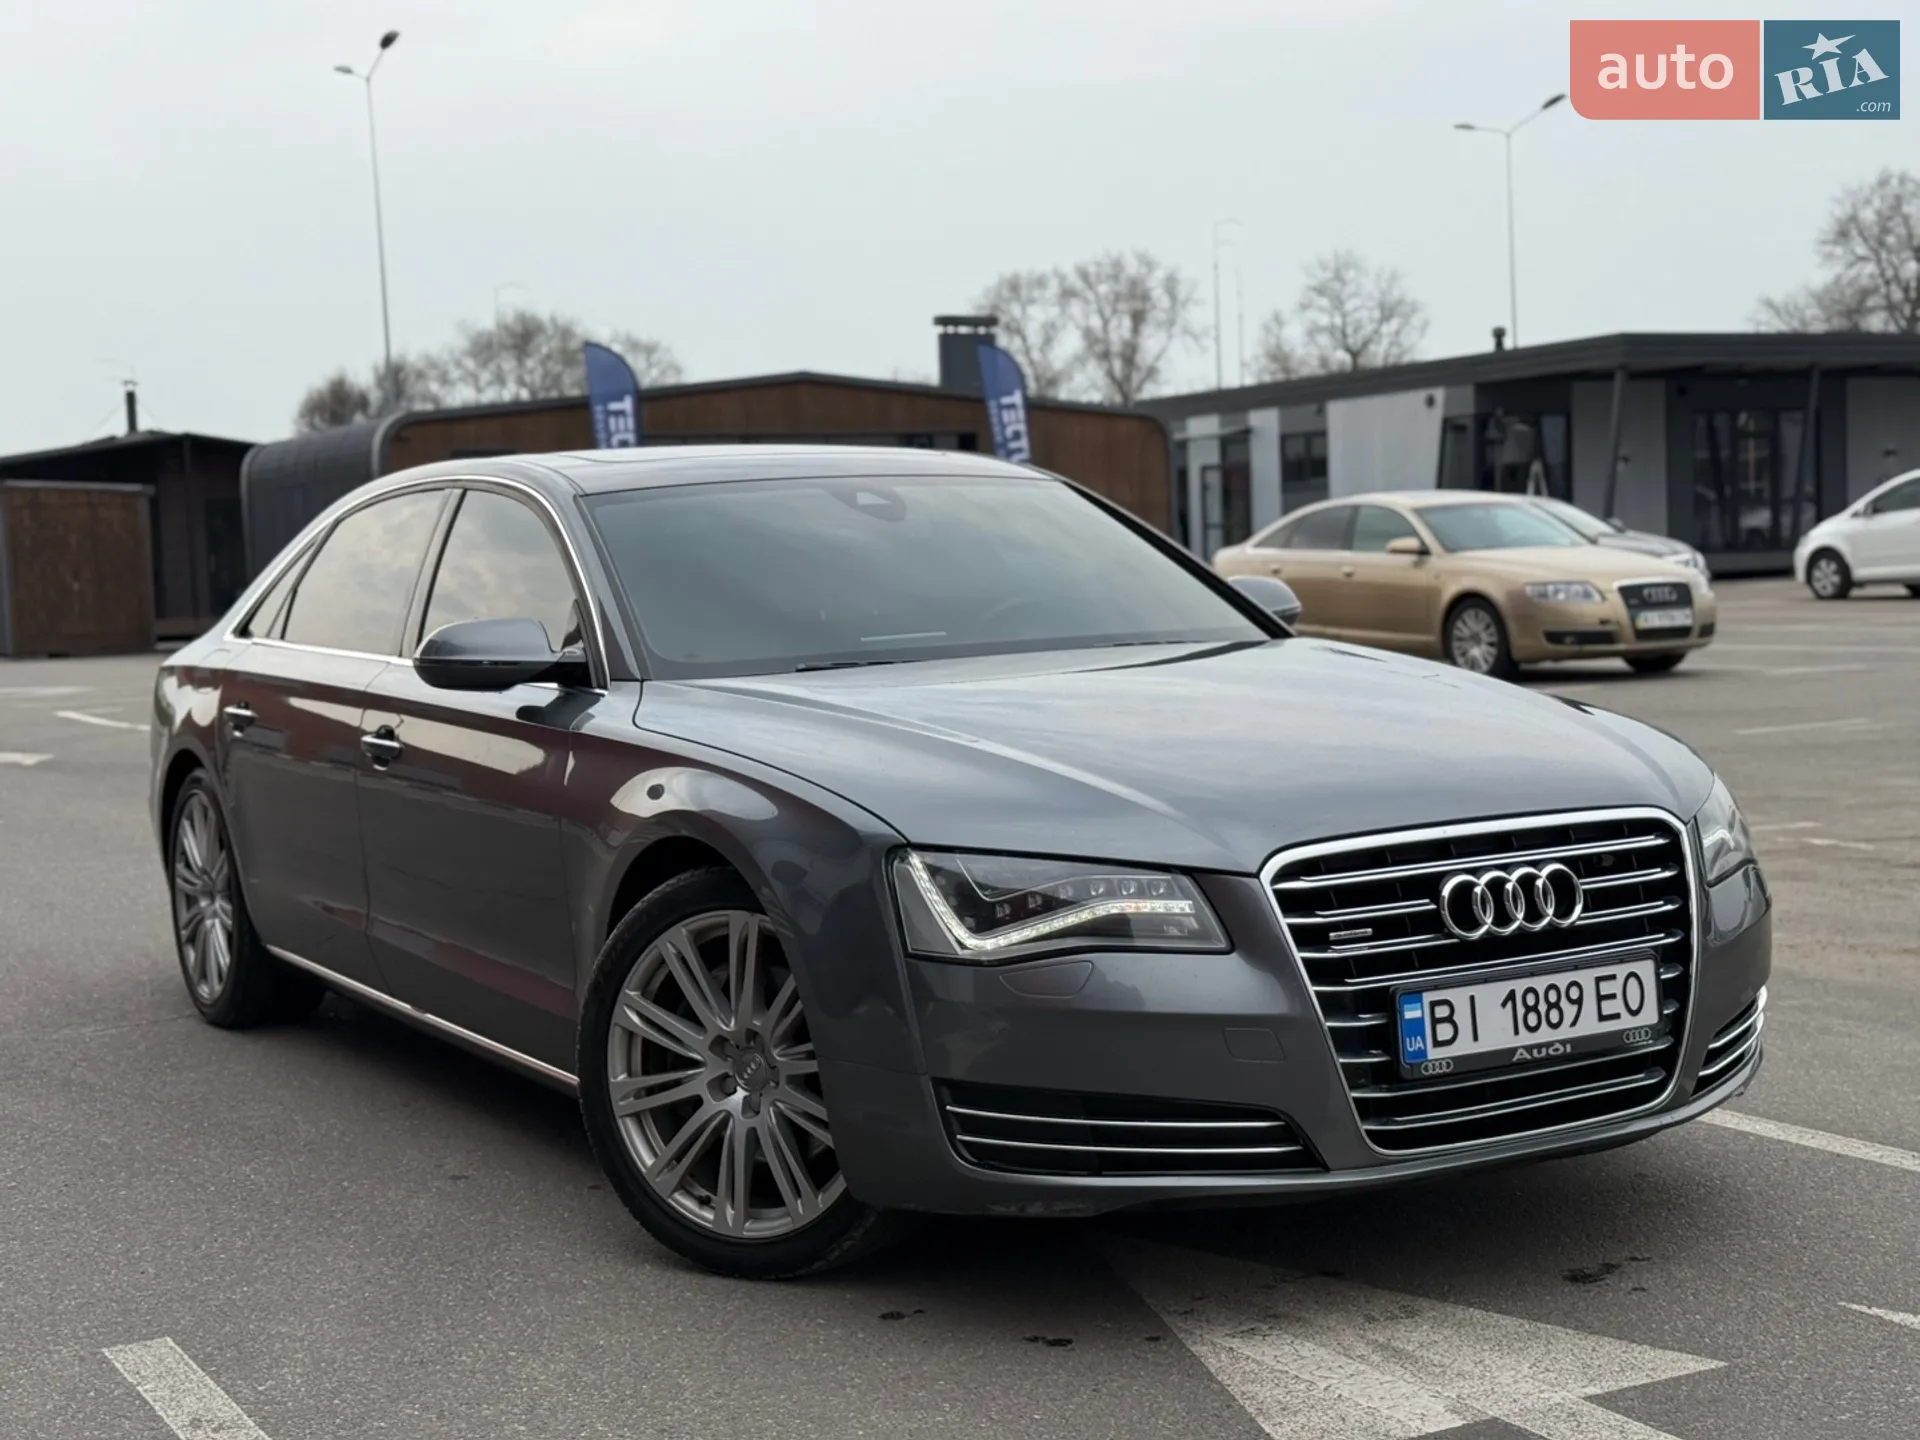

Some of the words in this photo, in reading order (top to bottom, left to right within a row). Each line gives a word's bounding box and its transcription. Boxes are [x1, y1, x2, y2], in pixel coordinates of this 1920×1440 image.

[1429, 994, 1479, 1049] BI
[1500, 979, 1584, 1037] 1889
[1594, 970, 1645, 1023] EO
[1406, 1036, 1425, 1052] UA
[1512, 1043, 1572, 1062] Audi
